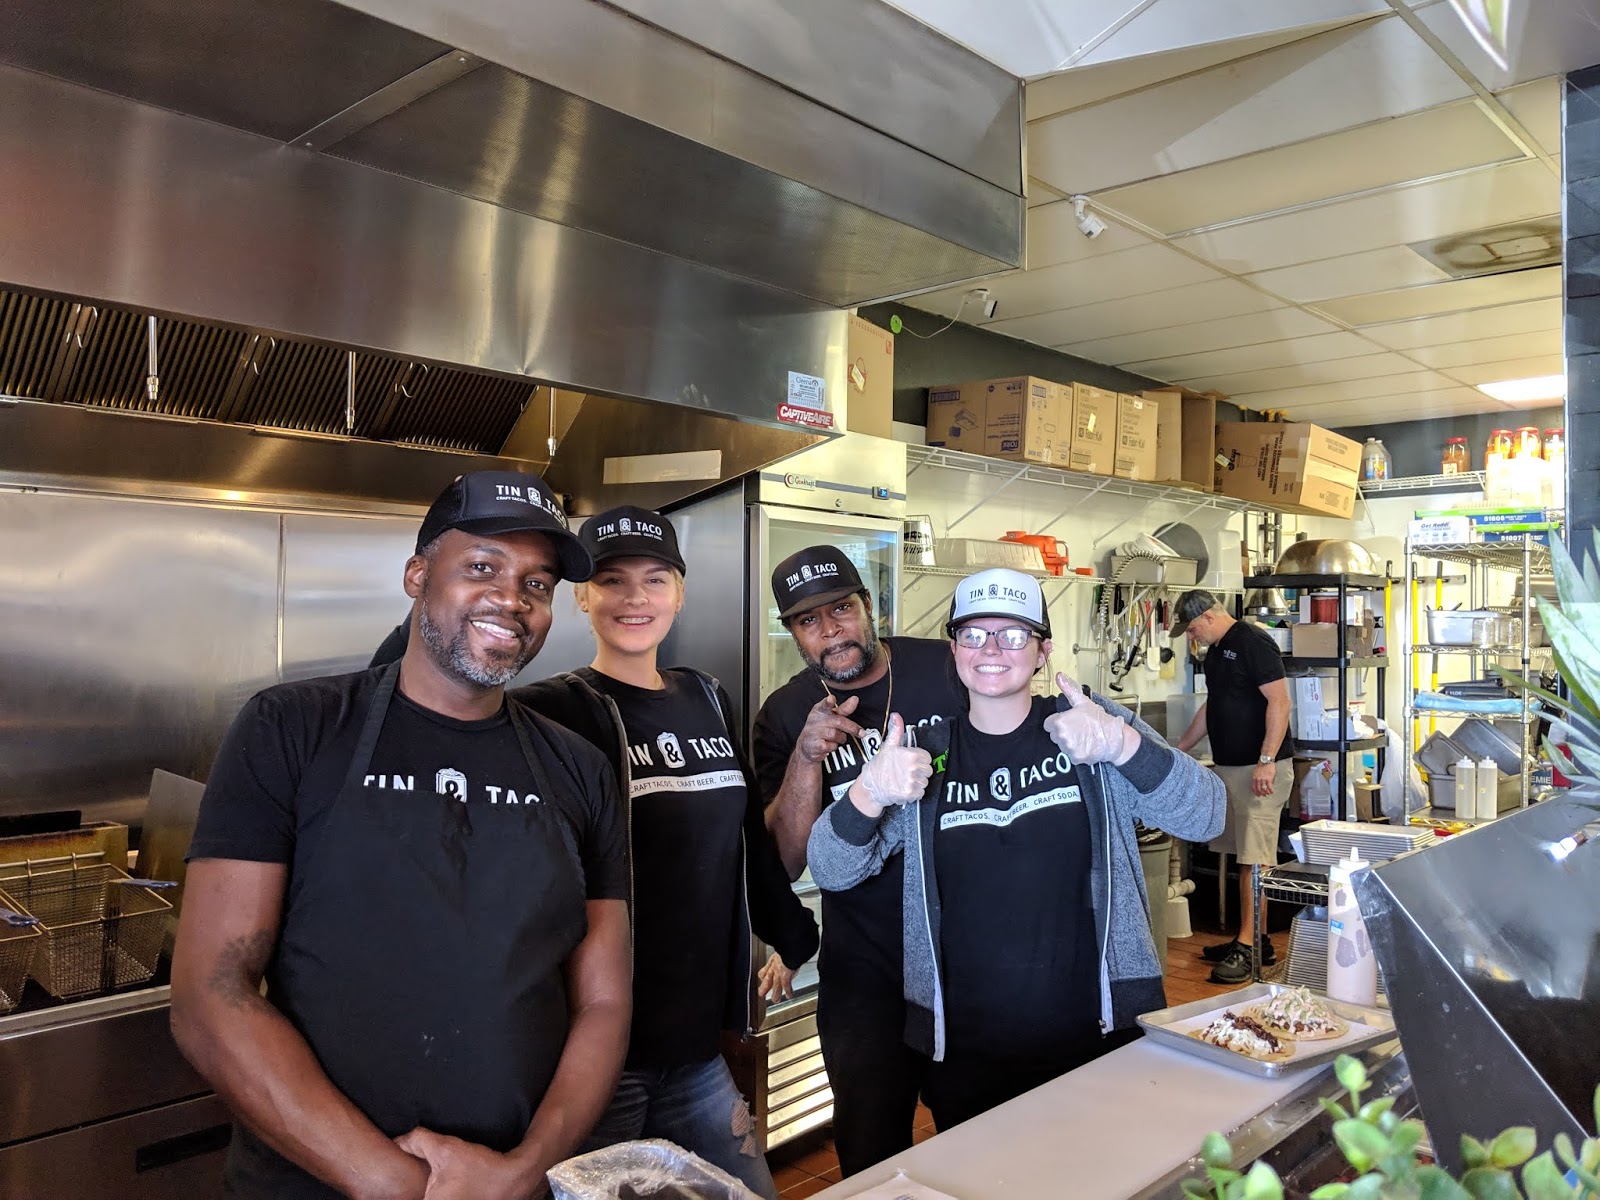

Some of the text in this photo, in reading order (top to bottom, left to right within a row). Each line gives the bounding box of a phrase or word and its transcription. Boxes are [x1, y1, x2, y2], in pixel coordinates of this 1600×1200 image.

[496, 485, 521, 497] TIN
[545, 498, 567, 527] TACO
[597, 522, 615, 537] TIN
[635, 521, 663, 536] TACO
[785, 572, 800, 587] TIN
[814, 562, 838, 574] TACO
[969, 588, 984, 600] TIN
[1003, 587, 1027, 601] TACO
[628, 743, 654, 766] IN
[687, 736, 734, 760] TACO
[676, 779, 696, 789] CRAFT
[719, 774, 738, 783] CRAFT
[946, 781, 979, 804] TIN
[1020, 751, 1072, 789] TACO
[943, 814, 963, 825] CRAFT
[1033, 794, 1056, 806] CRAFT
